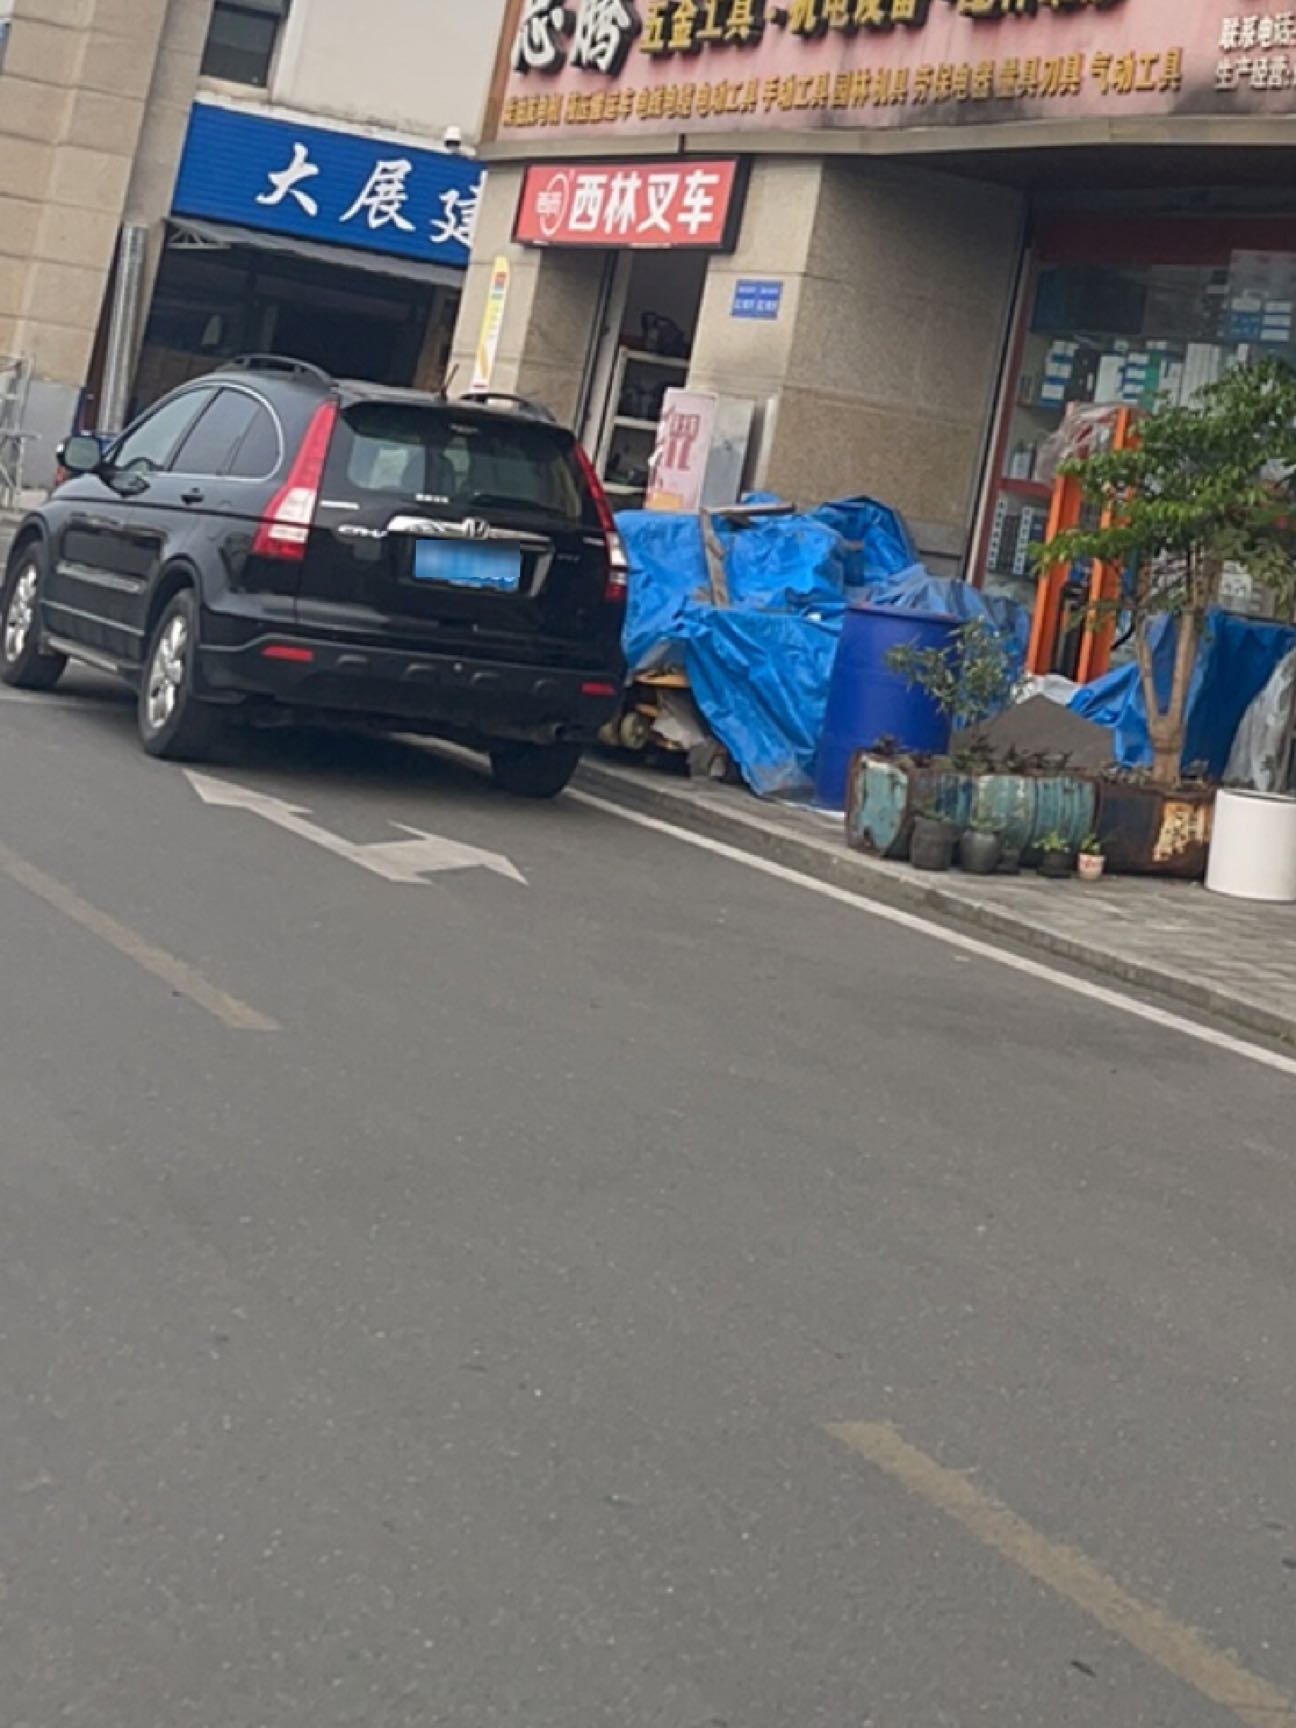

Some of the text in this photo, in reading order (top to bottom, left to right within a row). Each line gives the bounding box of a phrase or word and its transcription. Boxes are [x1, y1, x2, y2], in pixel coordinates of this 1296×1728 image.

[1090, 46, 1183, 95] 气动工具
[567, 169, 720, 234] 西林叉车
